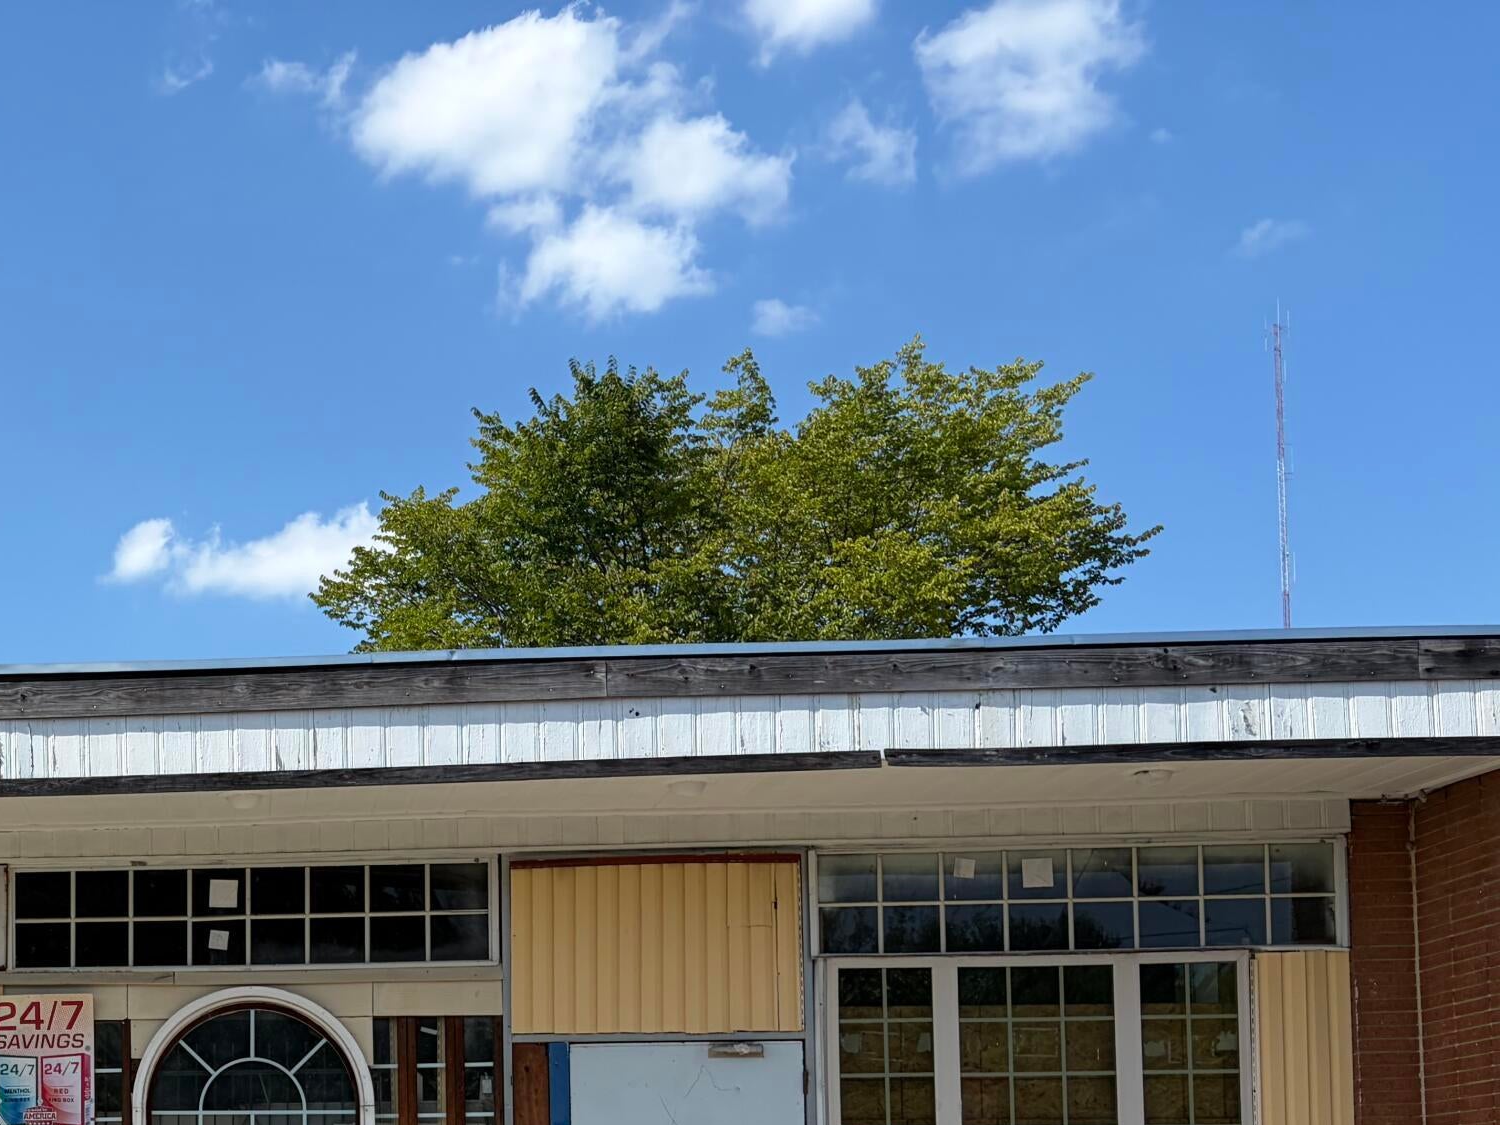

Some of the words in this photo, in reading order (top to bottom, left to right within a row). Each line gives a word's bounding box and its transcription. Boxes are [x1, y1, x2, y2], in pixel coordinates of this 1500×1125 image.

[0, 1063, 35, 1077] 24/7
[44, 1061, 80, 1076] 24/7
[24, 1112, 56, 1120] AMERICA
